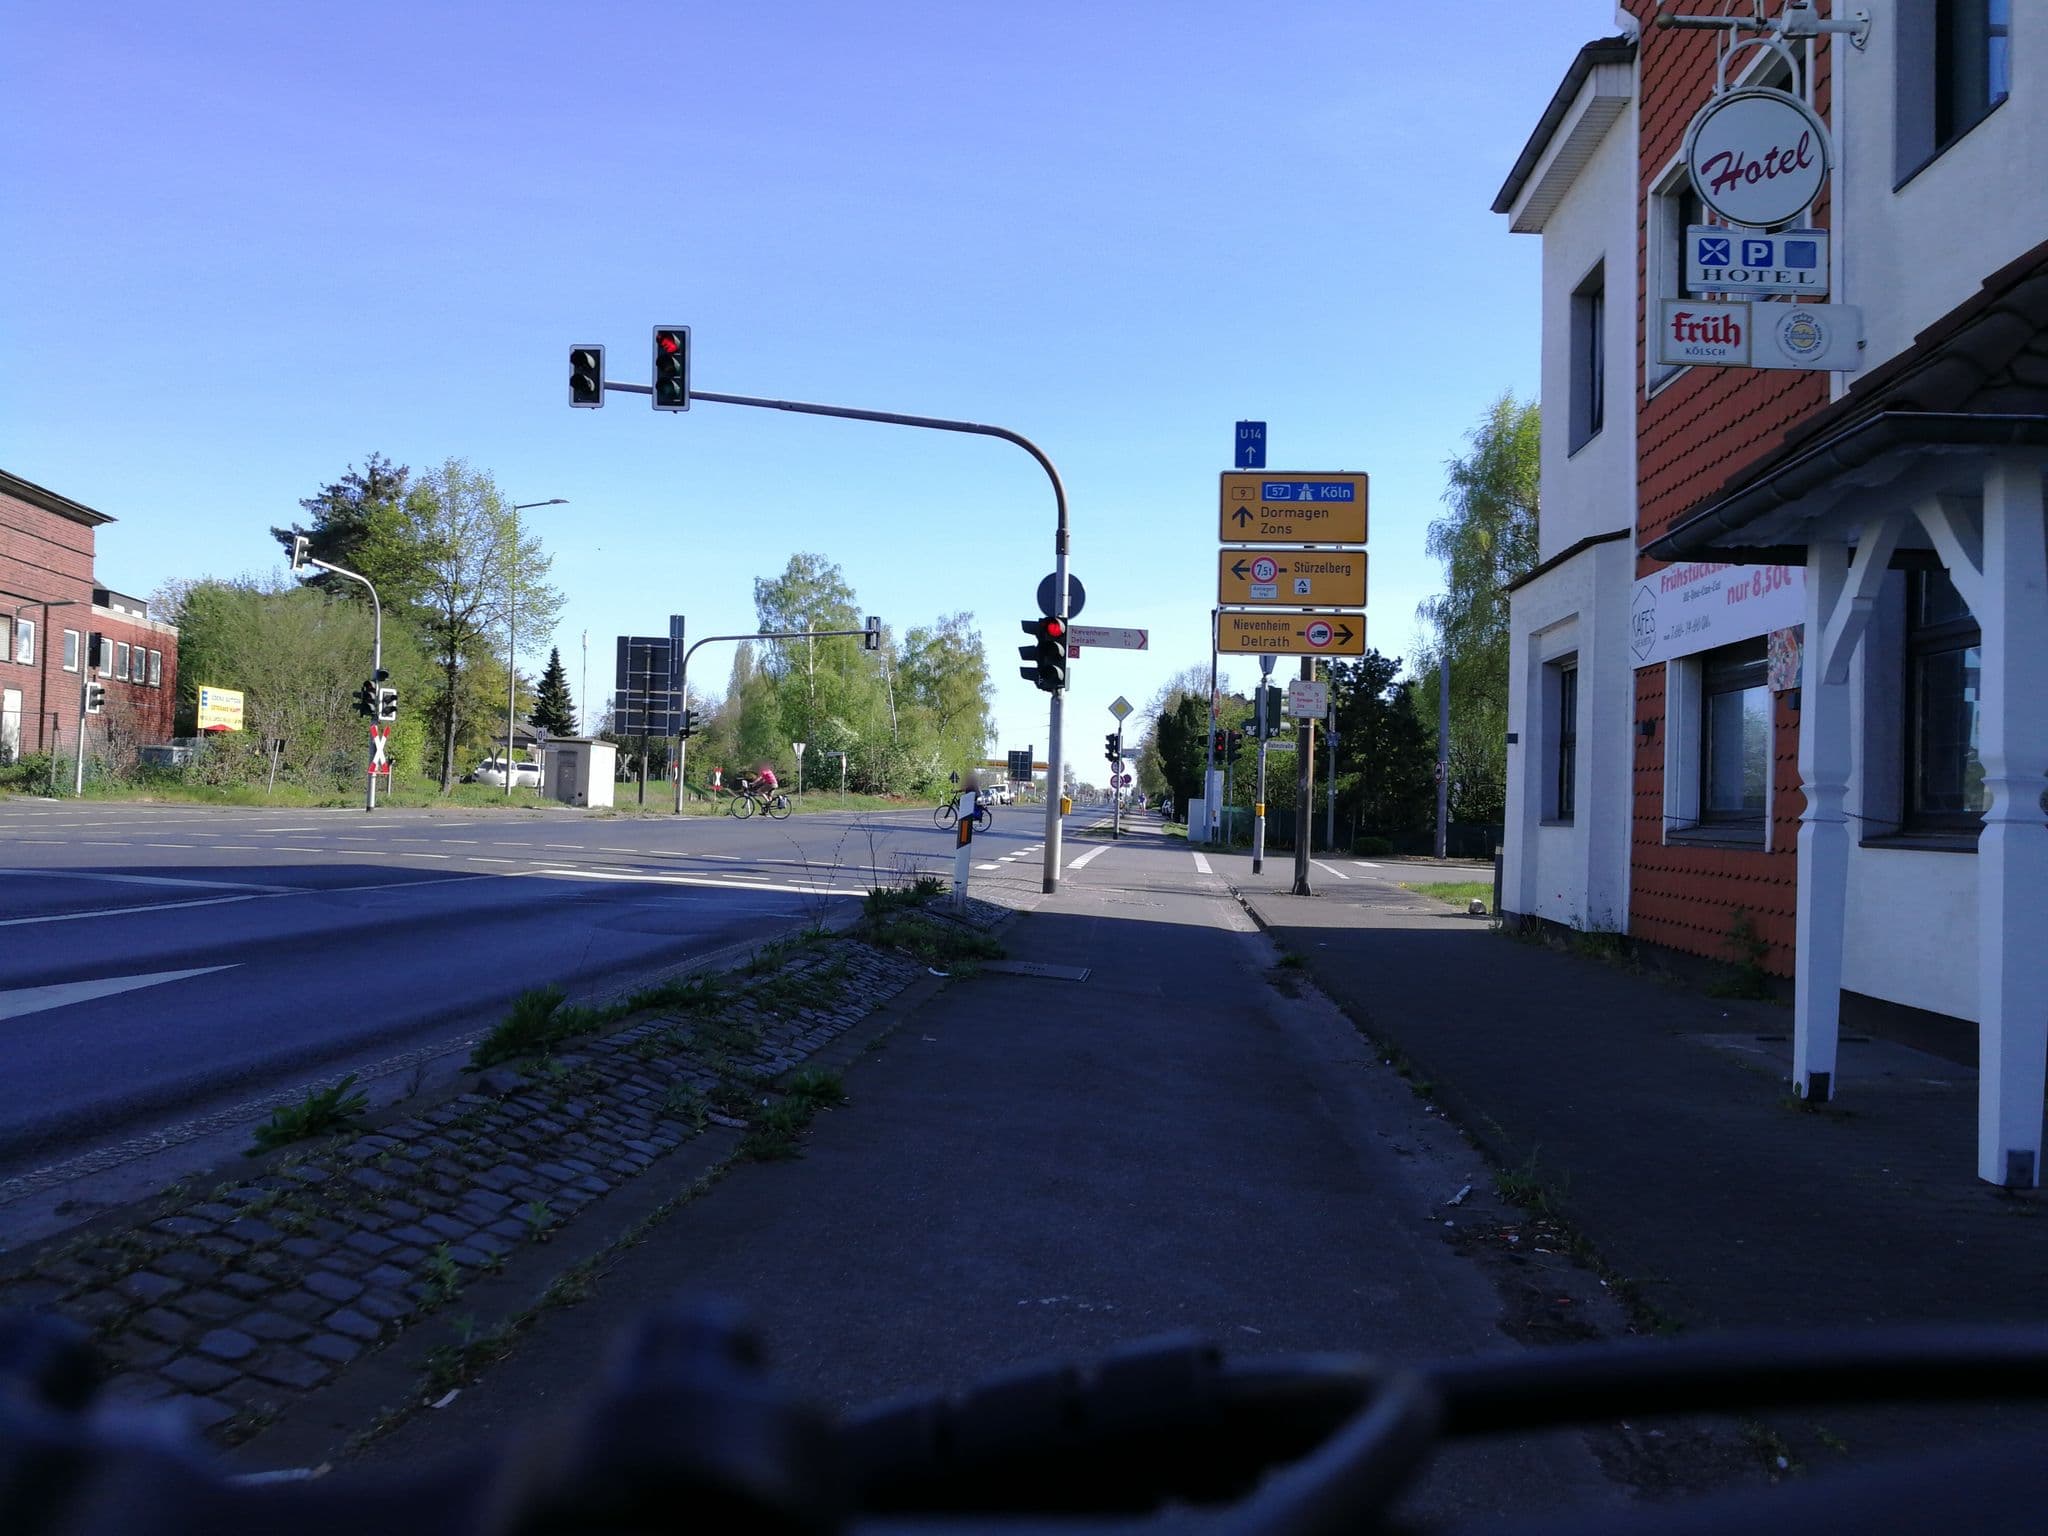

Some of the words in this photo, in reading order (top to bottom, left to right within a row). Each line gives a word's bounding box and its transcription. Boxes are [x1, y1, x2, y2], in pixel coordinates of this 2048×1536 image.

[1700, 130, 1815, 195] Hotel
[1702, 268, 1815, 284] HOTEL
[1671, 311, 1741, 348] früh
[1685, 344, 1726, 357] KÖLSCH
[1240, 489, 1246, 497] 9
[1271, 487, 1284, 496] 57
[1320, 486, 1351, 498] Köln
[1261, 507, 1329, 520] Dormagen
[1261, 523, 1292, 534] Zons
[1294, 561, 1351, 576] Stürzelberg
[1727, 581, 1749, 605] nur
[1233, 619, 1290, 631] Nievenheim
[1241, 635, 1290, 647] Delrath
